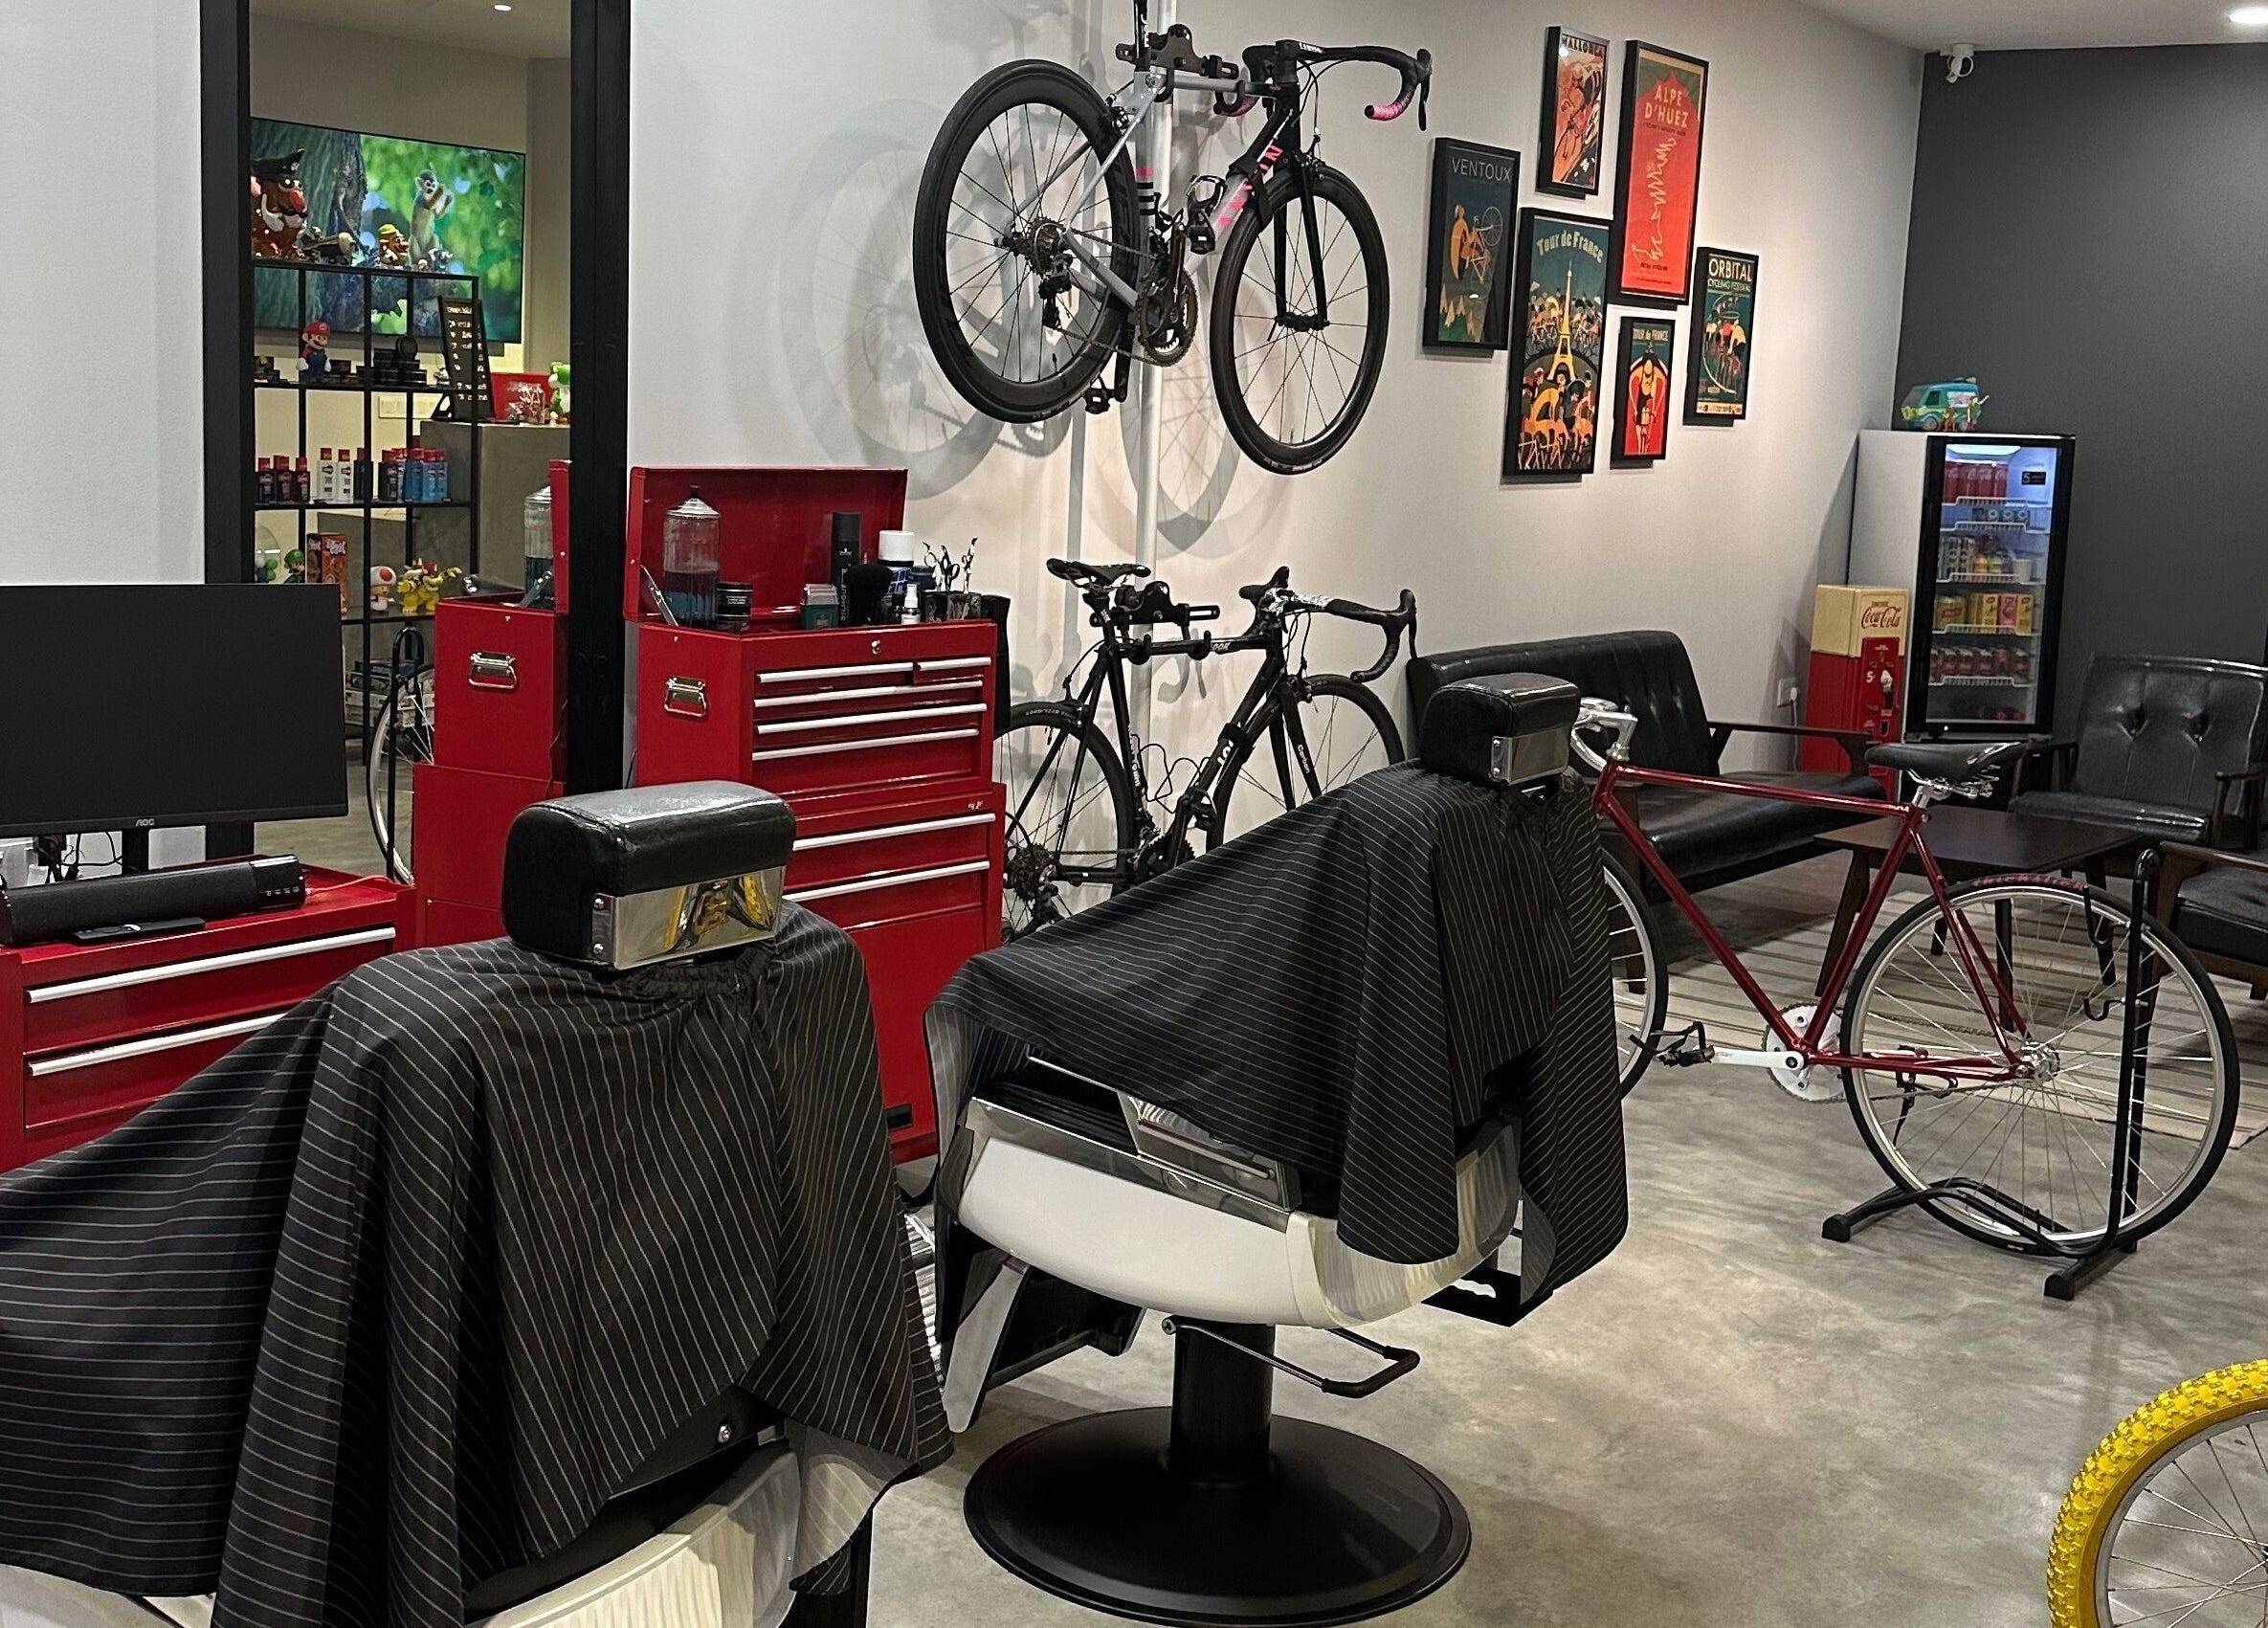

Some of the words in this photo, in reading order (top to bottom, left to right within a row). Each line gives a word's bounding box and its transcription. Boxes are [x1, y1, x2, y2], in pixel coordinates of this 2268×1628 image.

[1655, 85, 1682, 106] ALPE
[1644, 102, 1689, 128] D'HUEZ
[1452, 157, 1511, 183] VENTOUX
[1537, 234, 1560, 256] Tour
[1561, 230, 1572, 247] de
[1573, 232, 1604, 263] France
[1708, 258, 1752, 282] ORBITAL
[1861, 606, 1901, 629] Coca-Cola
[135, 818, 155, 827] AOC
